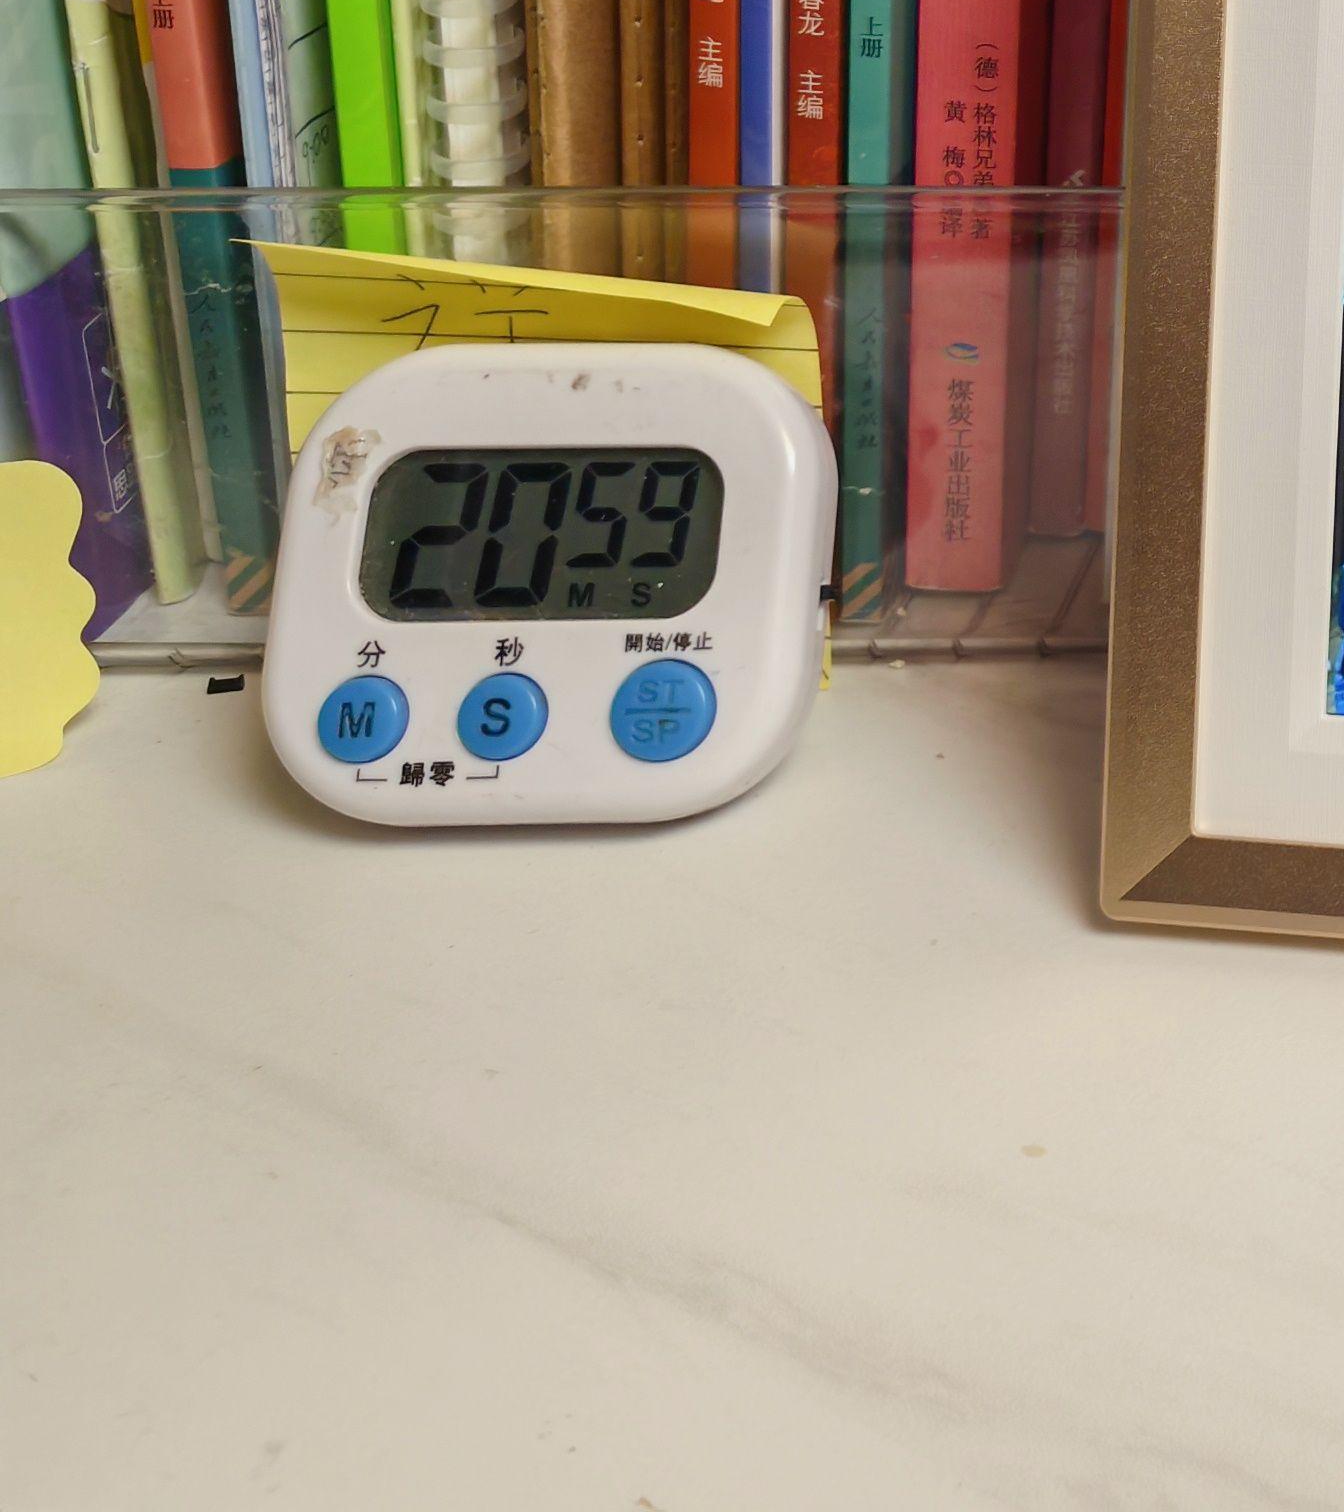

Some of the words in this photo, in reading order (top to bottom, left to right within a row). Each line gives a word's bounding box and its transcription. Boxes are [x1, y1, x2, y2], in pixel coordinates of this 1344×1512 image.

[860, 16, 883, 59] 上册
[698, 37, 724, 88] 主编
[798, 70, 824, 120] 主编
[944, 378, 974, 542] 煤炭工业出版社
[567, 583, 595, 608] M
[631, 582, 652, 607] S
[357, 640, 386, 668] 分
[494, 637, 524, 667] 秒
[624, 631, 714, 654] 開始/停止
[636, 678, 684, 705] ST
[338, 701, 376, 738] M
[480, 697, 511, 737] S
[631, 718, 681, 745] SP
[399, 760, 455, 788] 歸零
